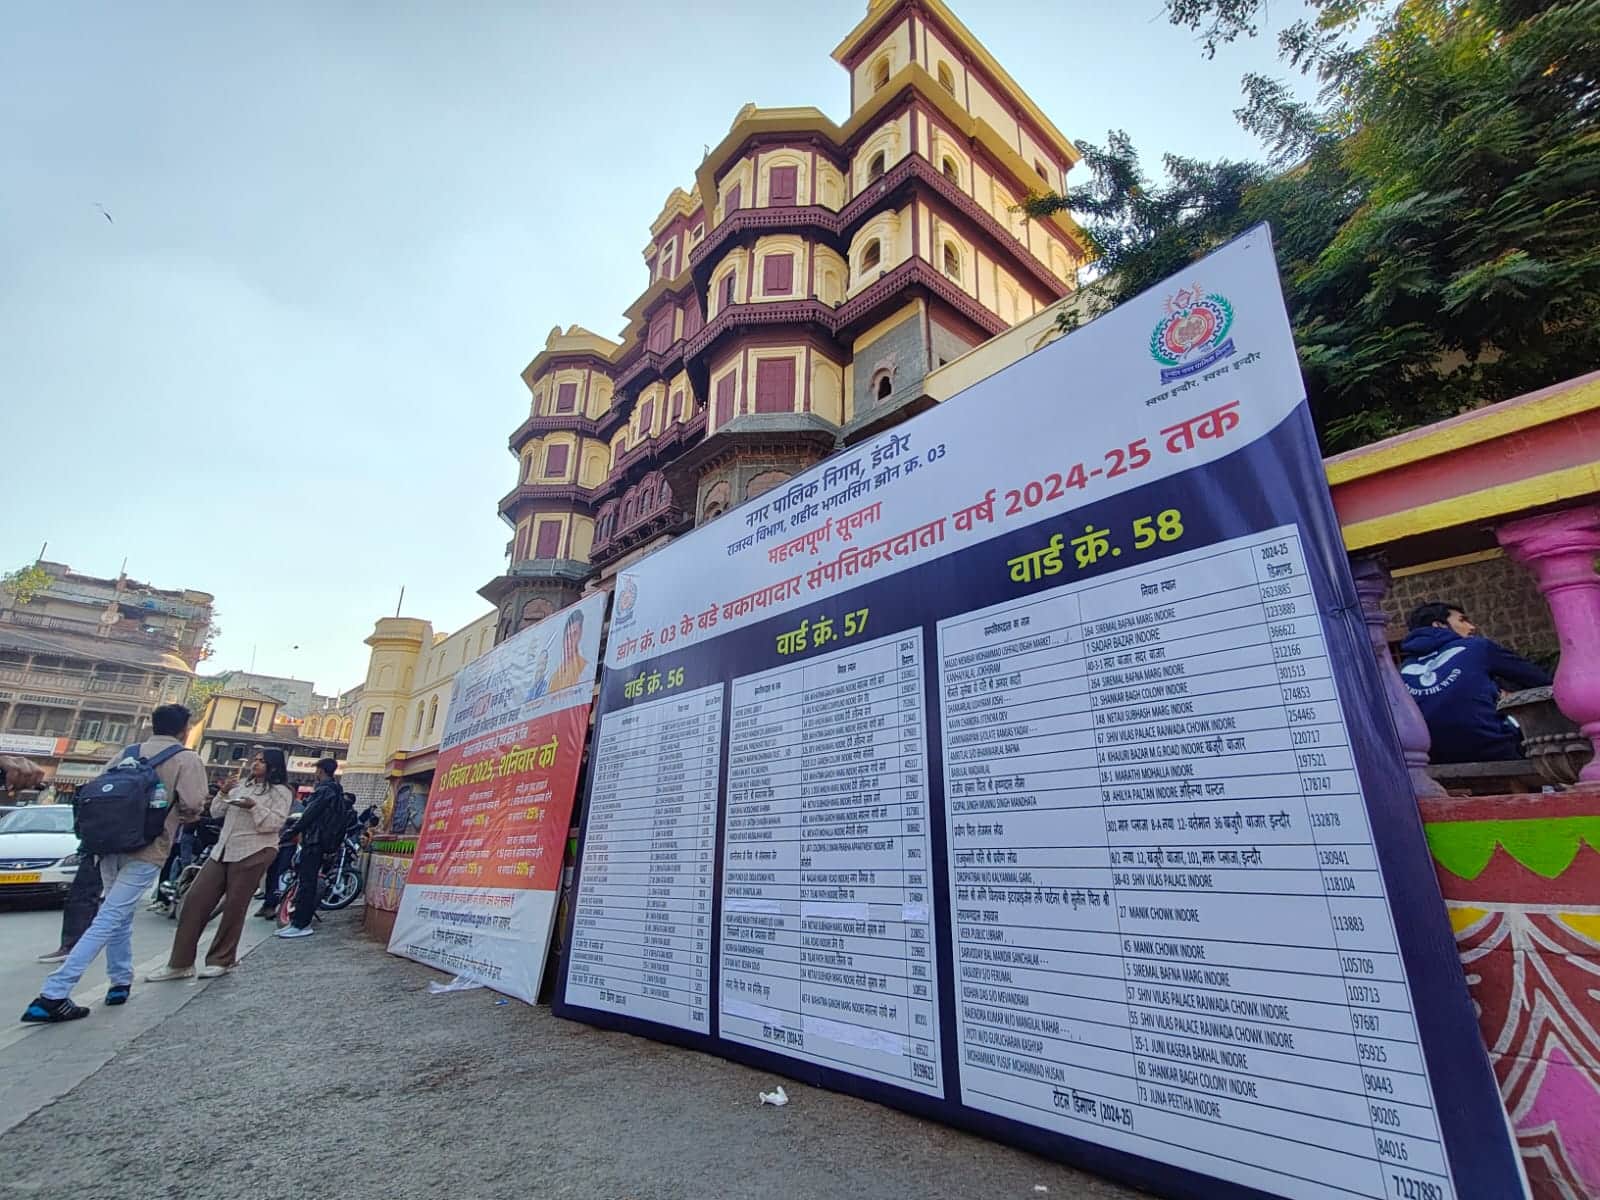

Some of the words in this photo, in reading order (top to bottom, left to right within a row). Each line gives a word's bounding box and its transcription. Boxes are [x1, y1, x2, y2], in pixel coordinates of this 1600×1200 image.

[1232, 352, 1261, 370] इन्दौर
[745, 507, 769, 528] नगर
[773, 480, 819, 513] पालिक
[823, 458, 865, 491] निगम,
[871, 433, 911, 468] इंदौर
[727, 535, 754, 557] राजस्व
[755, 520, 787, 544] विभाग,
[790, 503, 819, 527] शहीद
[873, 465, 900, 490] झोन
[903, 455, 922, 476] क्र.
[927, 443, 946, 463] 03
[616, 638, 637, 662] झोन
[639, 628, 656, 655] क्रं.
[660, 625, 676, 645] 03
[679, 614, 695, 636] के
[723, 574, 802, 621] बकायादार
[807, 516, 946, 590] संपत्तिकरदाता
[952, 489, 996, 532] वर्ष
[1004, 438, 1152, 516] 2024-25
[1160, 400, 1240, 453] तक
[836, 501, 883, 543] सूचना
[1007, 533, 1064, 584] वार्ड
[1071, 524, 1121, 569] क्रं.
[1133, 508, 1184, 550] 58
[1260, 543, 1289, 560] 2024-25
[1261, 582, 1291, 599] 2623885
[1265, 602, 1296, 618] 1233889
[776, 620, 808, 656] वार्ड
[812, 615, 838, 648] क्रं.
[844, 608, 870, 637] 57
[1090, 638, 1112, 652] SADAR
[1112, 633, 1134, 648] BAZAR
[1134, 628, 1160, 643] INDORE
[1269, 624, 1296, 638] 366622
[1273, 643, 1301, 658] 312166
[1278, 664, 1306, 679] 301513
[1440, 668, 1462, 687] WIND
[624, 672, 646, 700] वार्ड
[647, 665, 663, 694] क्रं.
[667, 667, 684, 689] 56
[1091, 695, 1098, 706] 12
[1099, 691, 1123, 705] SHANKAR
[1124, 688, 1141, 701] BAGH
[1141, 685, 1165, 698] COLONY
[1165, 681, 1188, 695] INDORE
[1282, 685, 1311, 700] 274853
[1287, 707, 1316, 722] 254465
[1097, 732, 1104, 743] 67
[1106, 730, 1118, 742] SHIV
[1118, 729, 1134, 741] VILAS
[1134, 726, 1156, 739] PALACE
[1156, 723, 1186, 737] RAJWADA
[1185, 720, 1210, 734] CHOWK
[1210, 717, 1236, 731] INDORE
[1292, 729, 1321, 744] 220717
[498, 745, 535, 777] शनिवार
[538, 735, 559, 769] को
[1098, 752, 1105, 762] 14
[1107, 749, 1129, 762] KHAJURI
[1129, 747, 1149, 760] BAZAR
[1180, 742, 1204, 755] INDORE
[1297, 753, 1327, 767] 197521
[1100, 770, 1112, 782] 18-1
[1114, 768, 1140, 781] MARATHI
[1140, 765, 1170, 779] MOHALLA
[1170, 763, 1194, 777] INDORE
[1302, 777, 1332, 791] 178747
[1310, 812, 1341, 826] 132878
[1318, 851, 1349, 864] 130941
[1131, 873, 1144, 885] SHIV
[1145, 873, 1163, 886] VILAS
[1163, 873, 1187, 887] PALACE
[1187, 874, 1213, 887] INDORE
[1324, 877, 1356, 891] 118104
[1119, 905, 1127, 918] 27
[1128, 906, 1149, 919] MANIK
[1149, 907, 1174, 921] CHOWK
[1174, 908, 1199, 922] INDORE
[1332, 916, 1365, 932] 113883
[1132, 940, 1154, 954] MANIK
[1154, 942, 1179, 956] CHOWK
[1180, 944, 1205, 959] INDORE
[1126, 962, 1130, 975] 5
[1132, 963, 1159, 978] SIREMAL
[1159, 966, 1181, 981] BAFNA
[1181, 968, 1203, 983] MARG
[1203, 970, 1230, 986] INDORE
[1341, 956, 1375, 974] 105709
[1126, 986, 1135, 1000] 57
[1137, 987, 1152, 1002] SHIV
[1152, 989, 1170, 1005] VILAS
[1170, 992, 1196, 1008] PALACE
[1195, 995, 1230, 1013] RAJWADA
[1229, 999, 1259, 1017] CHOWK
[1259, 1003, 1290, 1021] INDORE
[1347, 985, 1381, 1003] 103713
[1129, 1010, 1138, 1024] 55
[1140, 1012, 1155, 1027] SHIV
[1155, 1014, 1173, 1030] VILAS
[1173, 1017, 1199, 1034] PALACE
[1199, 1021, 1234, 1039] RAJWADA
[1234, 1026, 1264, 1044] CHOWK
[1263, 1030, 1295, 1049] INDORE
[1351, 1013, 1381, 1032] 97687
[1134, 1036, 1148, 1051] 35-1
[1150, 1038, 1166, 1054] JUNI
[1165, 1041, 1191, 1059] KASERA
[1192, 1045, 1219, 1064] BAKHAL
[1219, 1050, 1248, 1069] INDORE
[1357, 1042, 1387, 1063] 95925
[1137, 1060, 1146, 1075] 60
[1148, 1062, 1178, 1082] SHANKAR
[1178, 1068, 1199, 1086] BAGH
[1198, 1072, 1228, 1092] COLONY
[1228, 1078, 1258, 1098] INDORE
[1363, 1073, 1394, 1094] 90443
[1053, 1085, 1069, 1110] टोटल
[1100, 1100, 1134, 1130] (2024-25)
[1139, 1086, 1147, 1101] 73
[1149, 1088, 1167, 1106] JUNA
[1167, 1092, 1193, 1112] PEETHA
[1193, 1098, 1222, 1119] INDORE
[1370, 1105, 1401, 1127] 90205
[1376, 1137, 1409, 1161] 84016
[1392, 1174, 1443, 1200] 7127882
